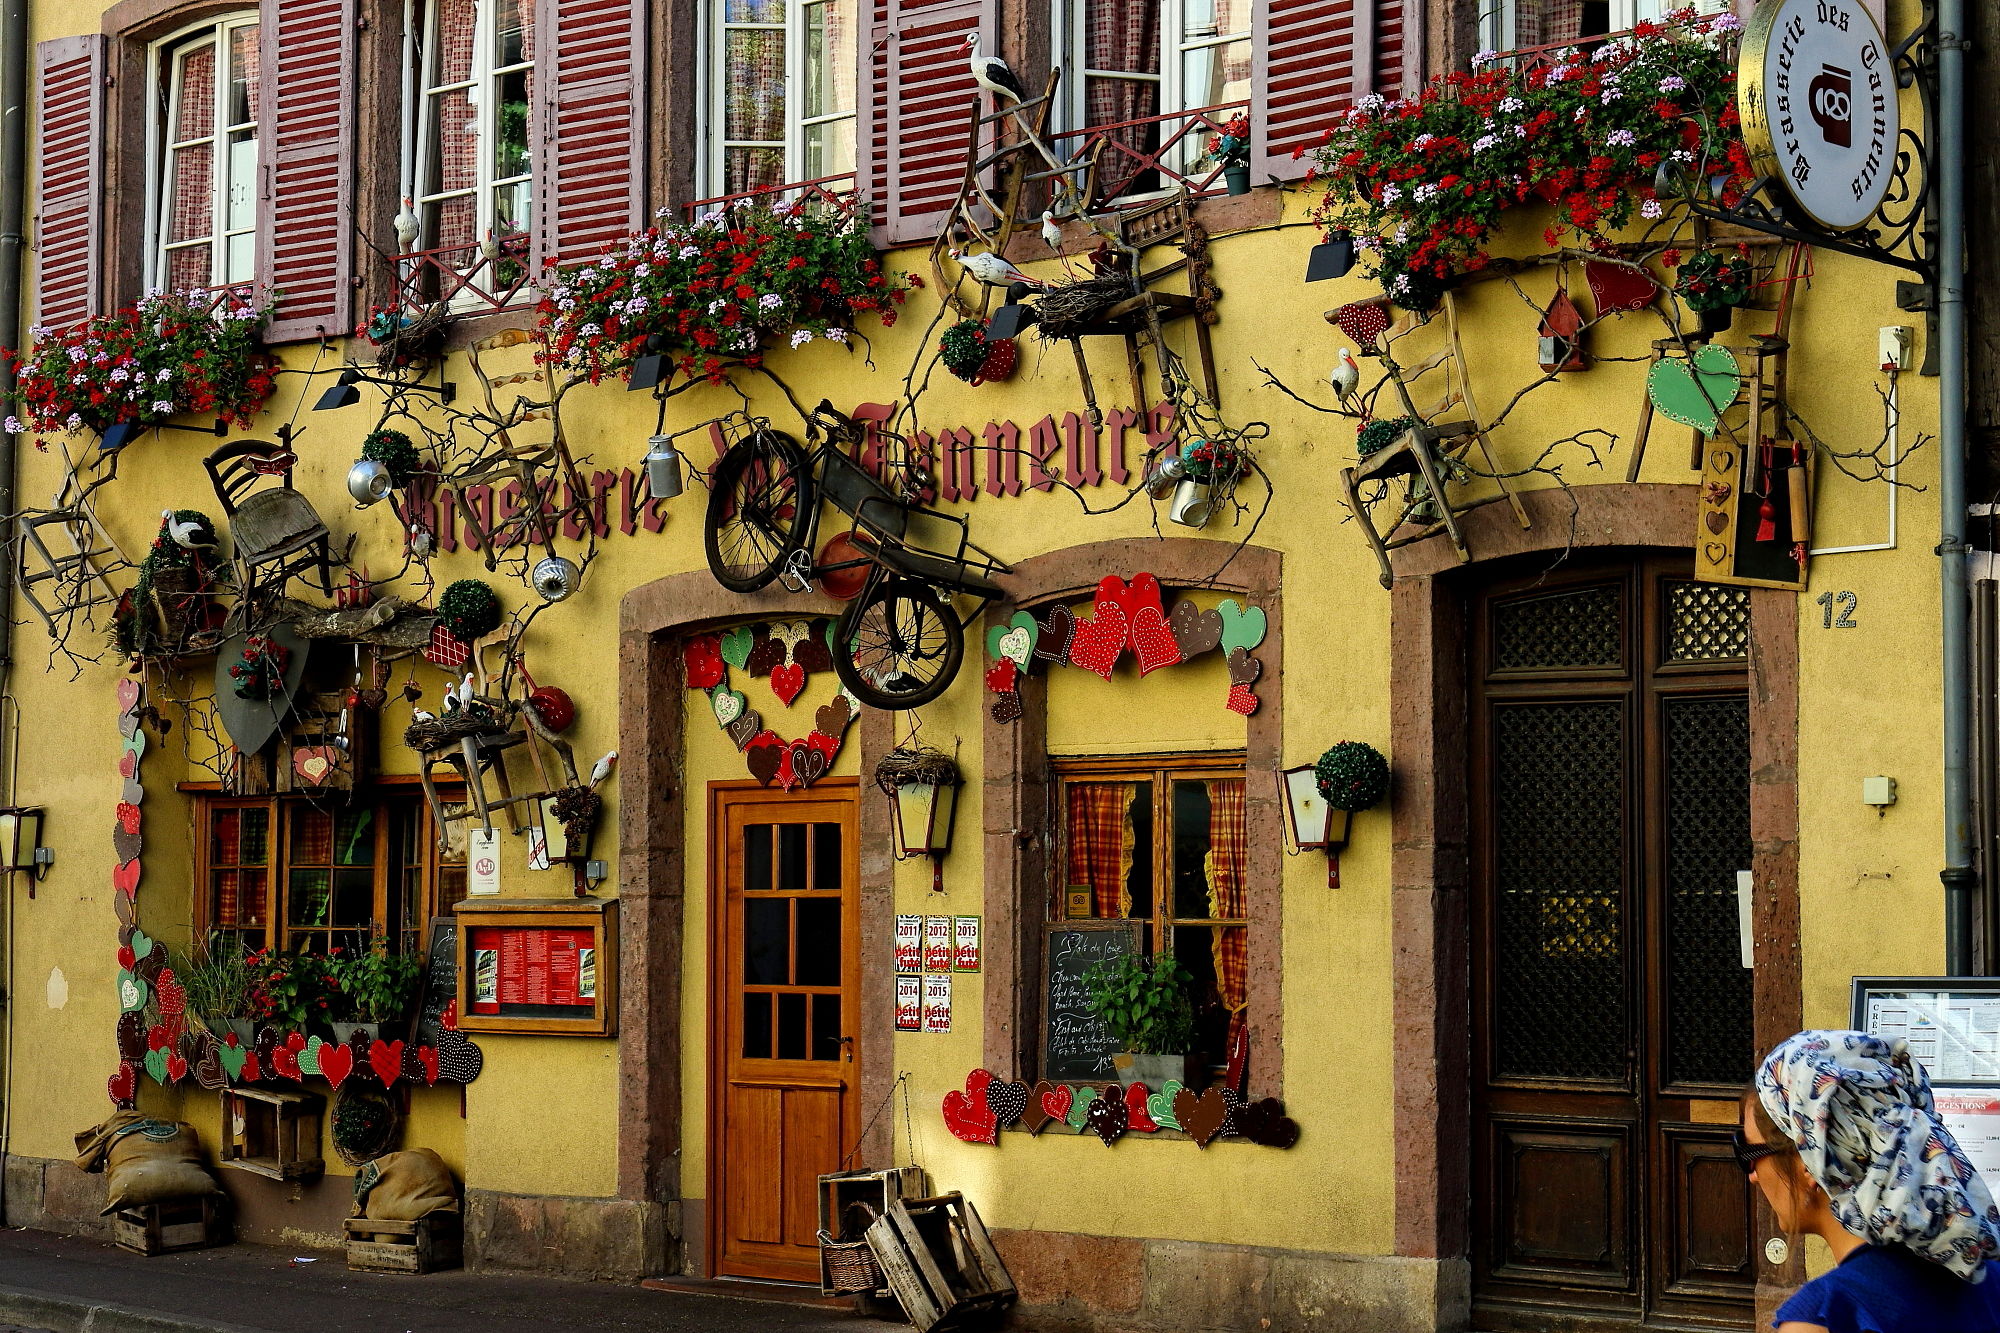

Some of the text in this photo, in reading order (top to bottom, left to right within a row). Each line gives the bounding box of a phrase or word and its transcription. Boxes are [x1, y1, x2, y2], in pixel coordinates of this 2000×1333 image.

[1777, 0, 1886, 202] Brasserie des Tanneurs
[1817, 590, 1857, 629] 12
[899, 925, 917, 936] 2011
[929, 925, 947, 936] 2012
[957, 925, 976, 936] 2013
[894, 945, 920, 958] petit
[925, 945, 950, 959] petit
[953, 945, 979, 960] petit
[899, 985, 918, 996] 2014
[928, 986, 947, 997] 2015
[895, 1005, 920, 1017] petit
[925, 1006, 950, 1019] petit
